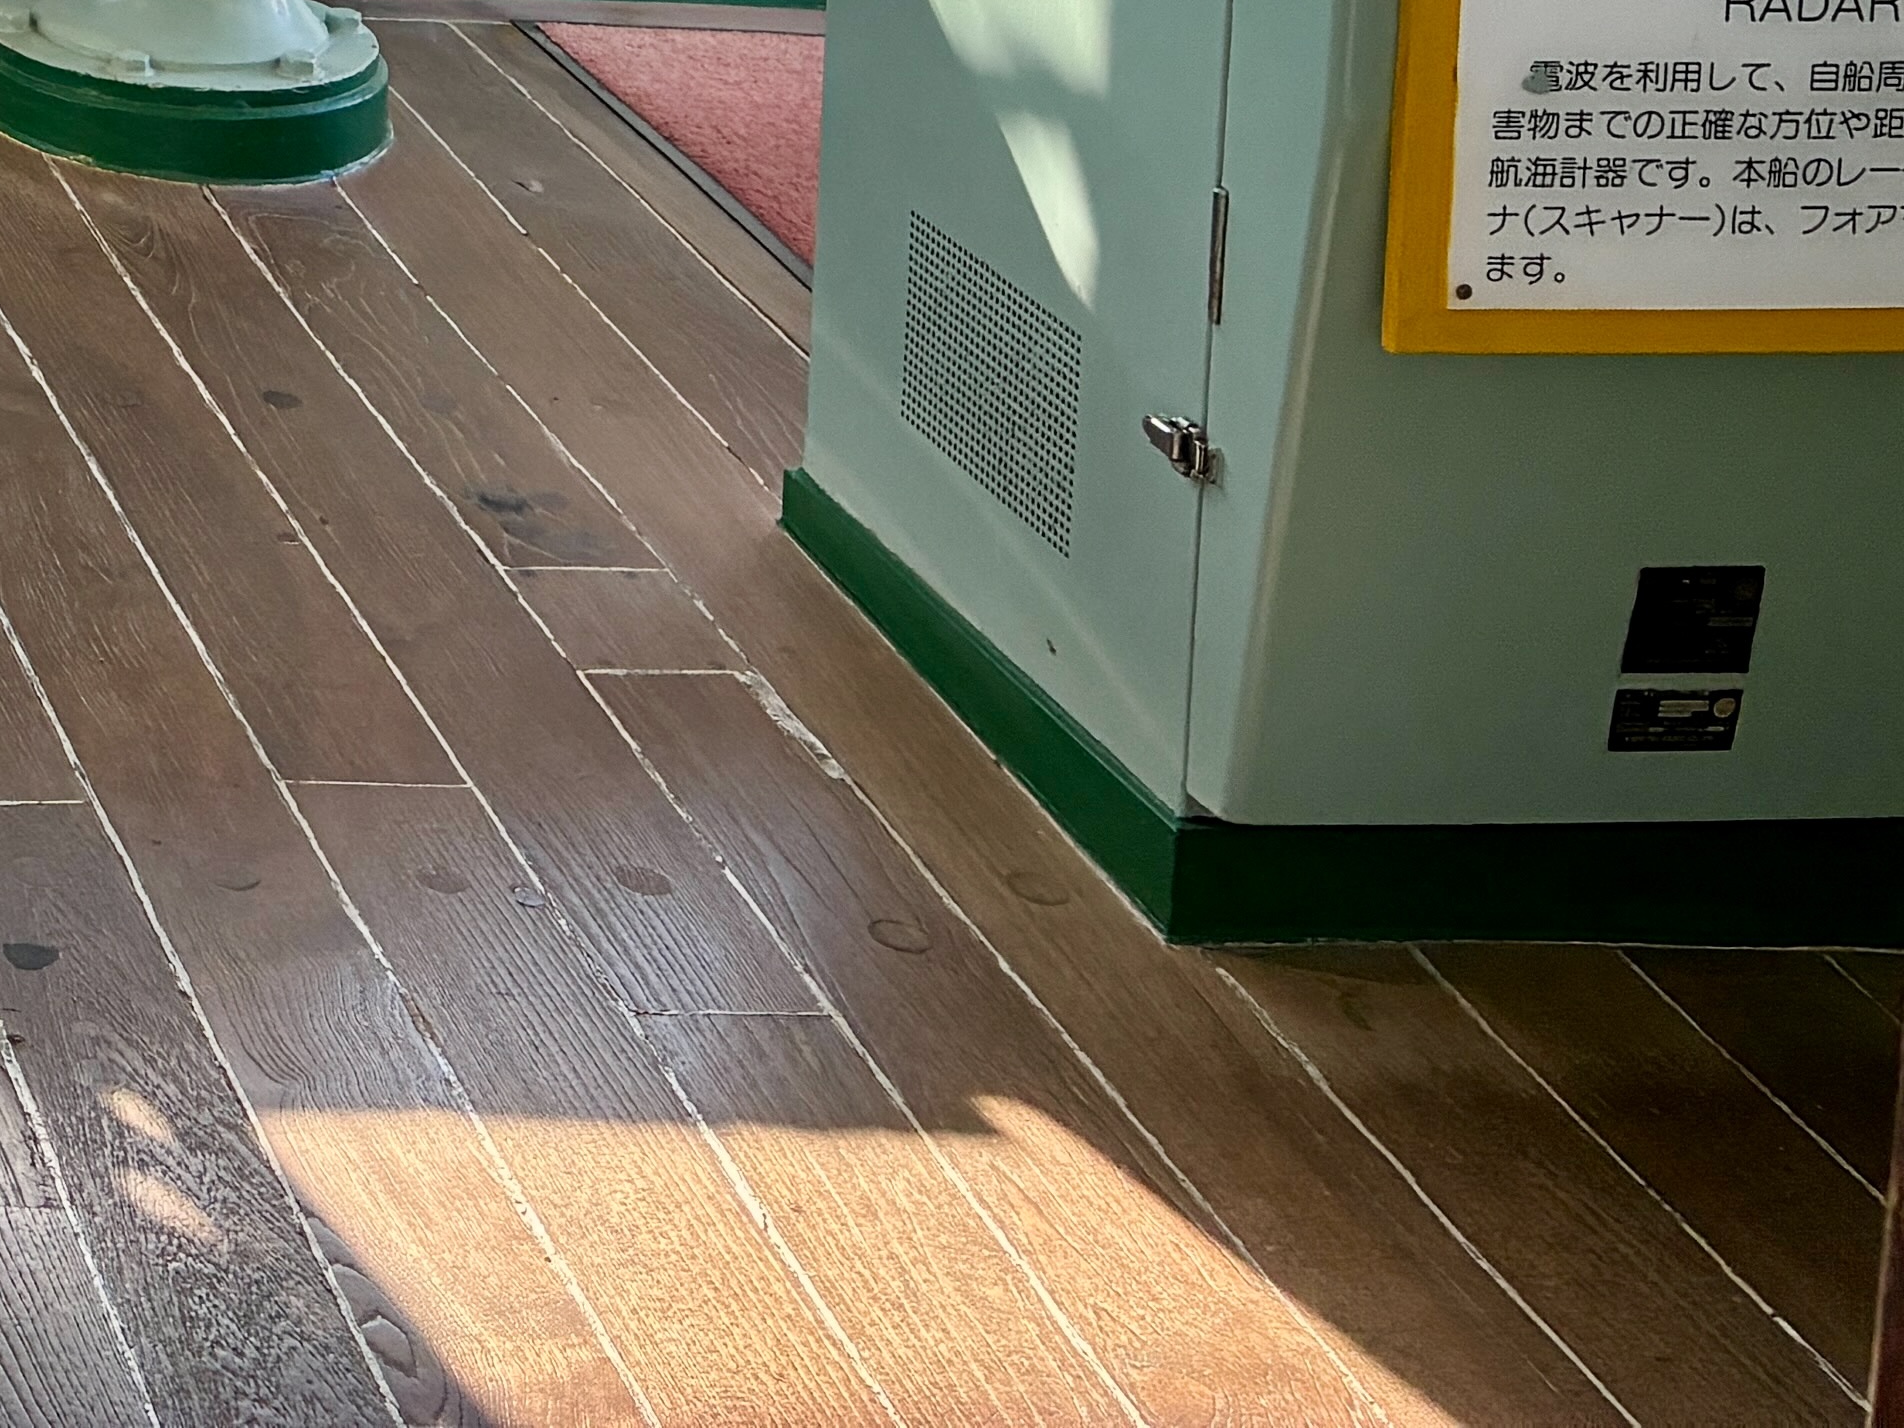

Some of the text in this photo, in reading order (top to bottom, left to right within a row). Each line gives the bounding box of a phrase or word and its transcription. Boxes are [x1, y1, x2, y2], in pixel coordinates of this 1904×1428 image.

[1492, 108, 1904, 142] 害物までの正確な方位や距
[1486, 253, 1567, 285] ます。
